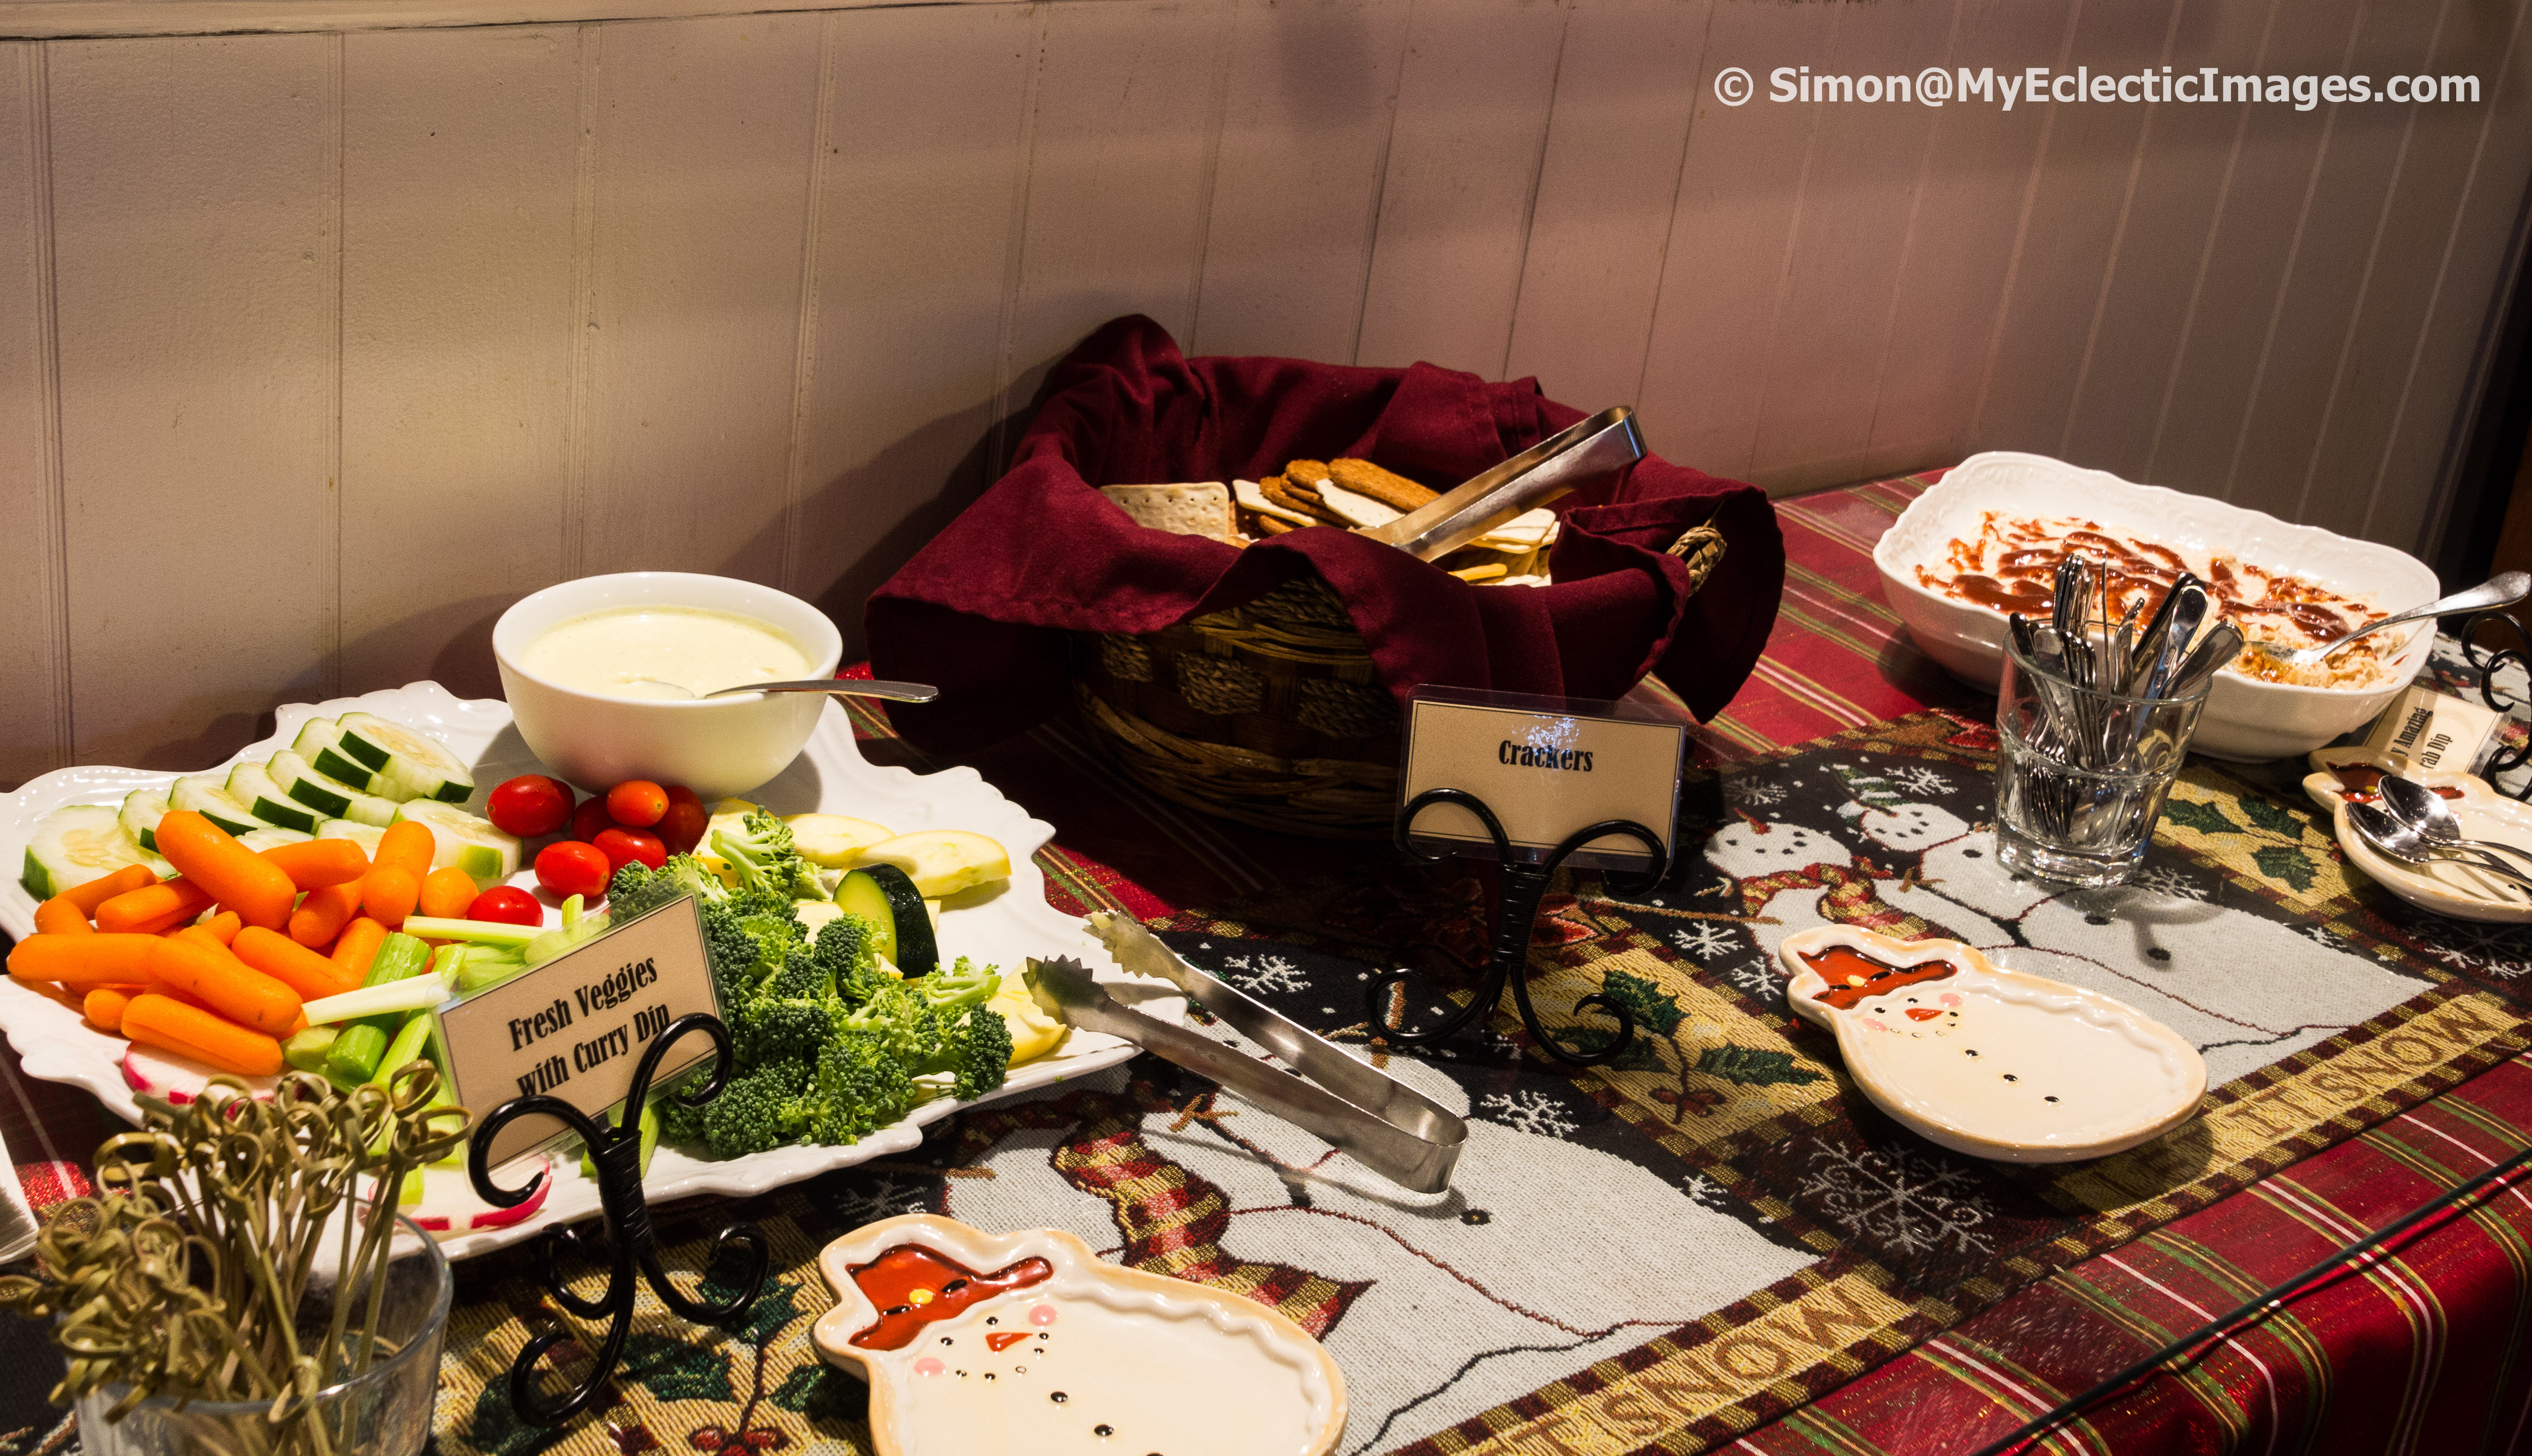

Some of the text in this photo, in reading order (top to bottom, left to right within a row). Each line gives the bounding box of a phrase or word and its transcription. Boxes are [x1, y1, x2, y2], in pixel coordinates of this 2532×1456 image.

[1498, 739, 1594, 772] Crackers
[2394, 707, 2434, 749] Amazing
[2420, 734, 2453, 769] rab Dip
[508, 957, 658, 1052] Fresh Veggies
[517, 1054, 570, 1097] with
[574, 1024, 629, 1073] Curry
[2310, 1000, 2501, 1102] SNOW
[1601, 1285, 1879, 1436] SNOW
